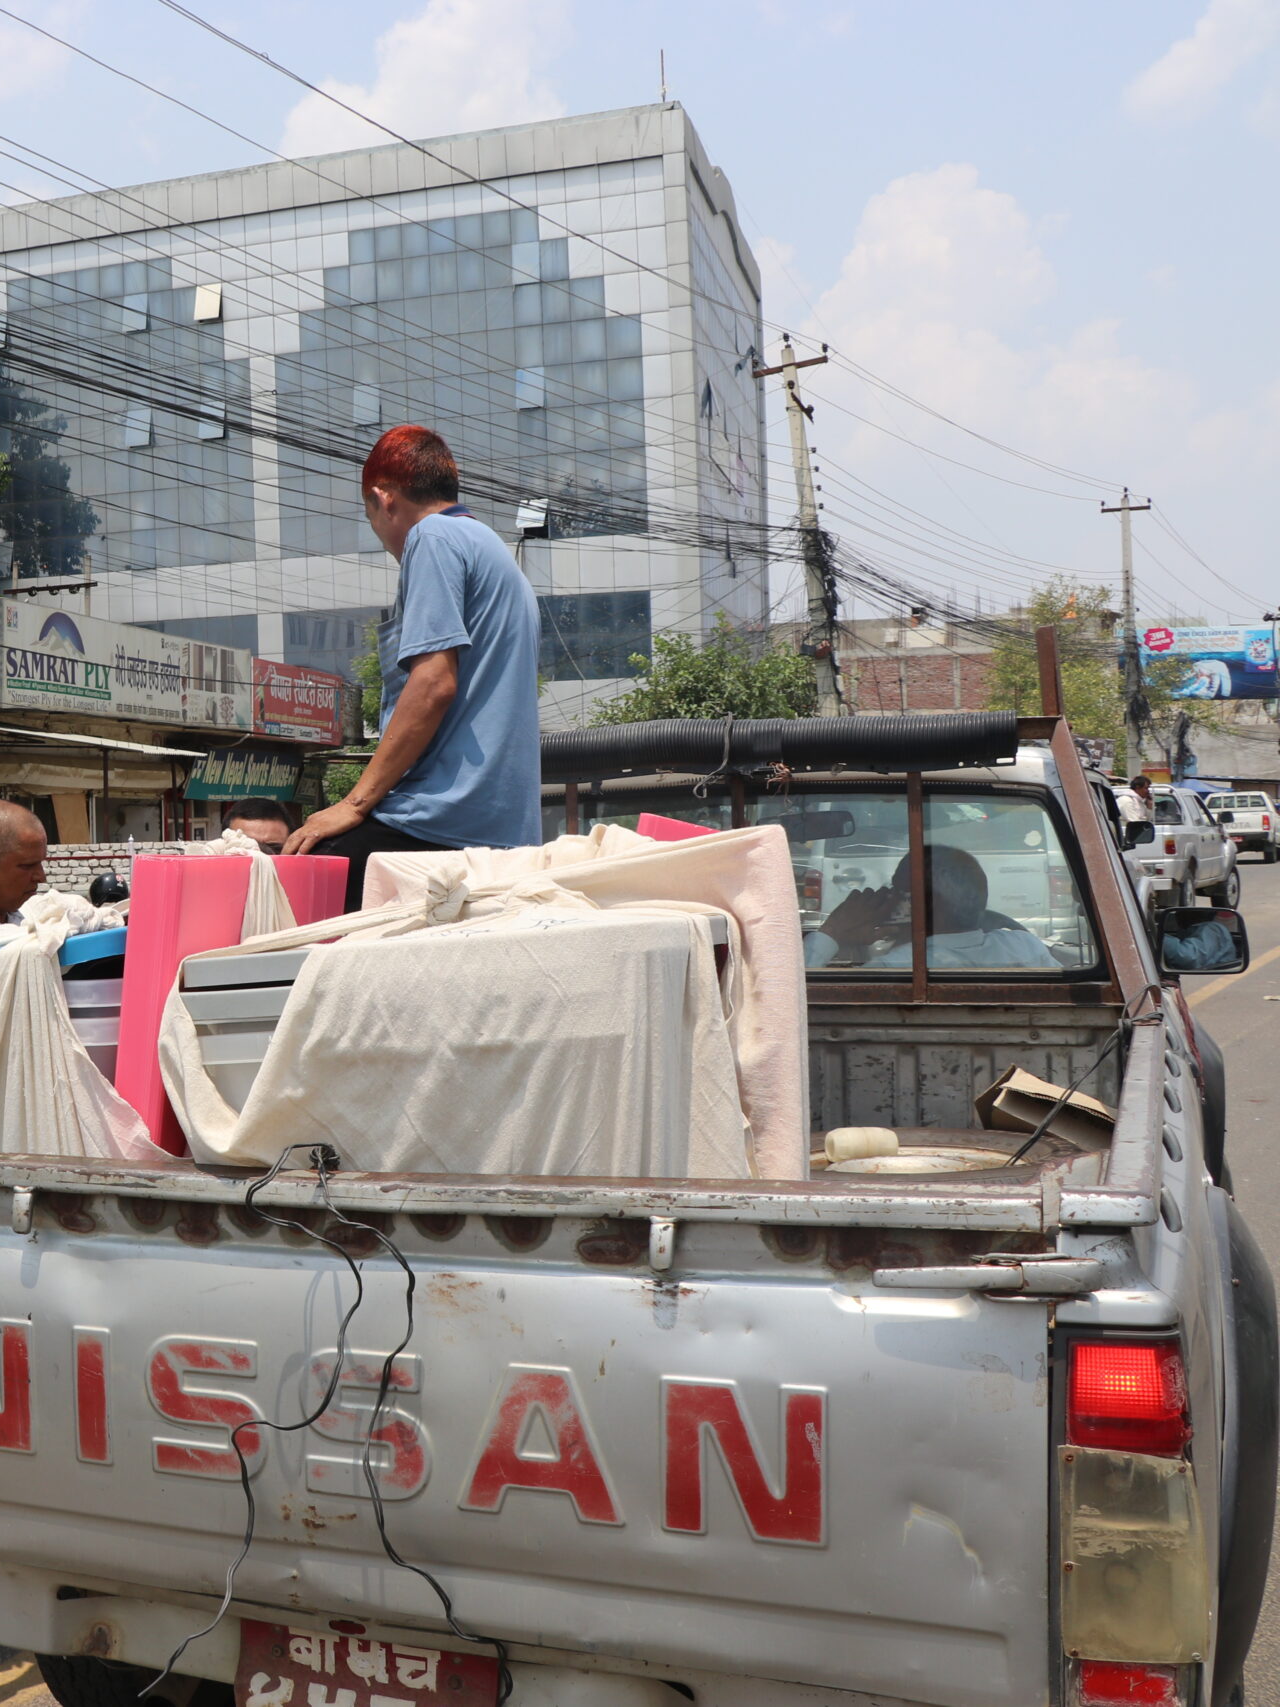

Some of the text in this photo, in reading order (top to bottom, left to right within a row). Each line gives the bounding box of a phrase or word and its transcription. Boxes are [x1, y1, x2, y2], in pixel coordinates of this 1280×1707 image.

[6, 648, 111, 690] SAMRAT PLY
[41, 693, 51, 707] Ply
[53, 694, 62, 707] for
[63, 695, 72, 708] the
[73, 697, 95, 711] Longest
[202, 750, 224, 784] New
[221, 752, 248, 793] Nepal
[244, 753, 270, 794] Sports
[267, 755, 290, 787] House
